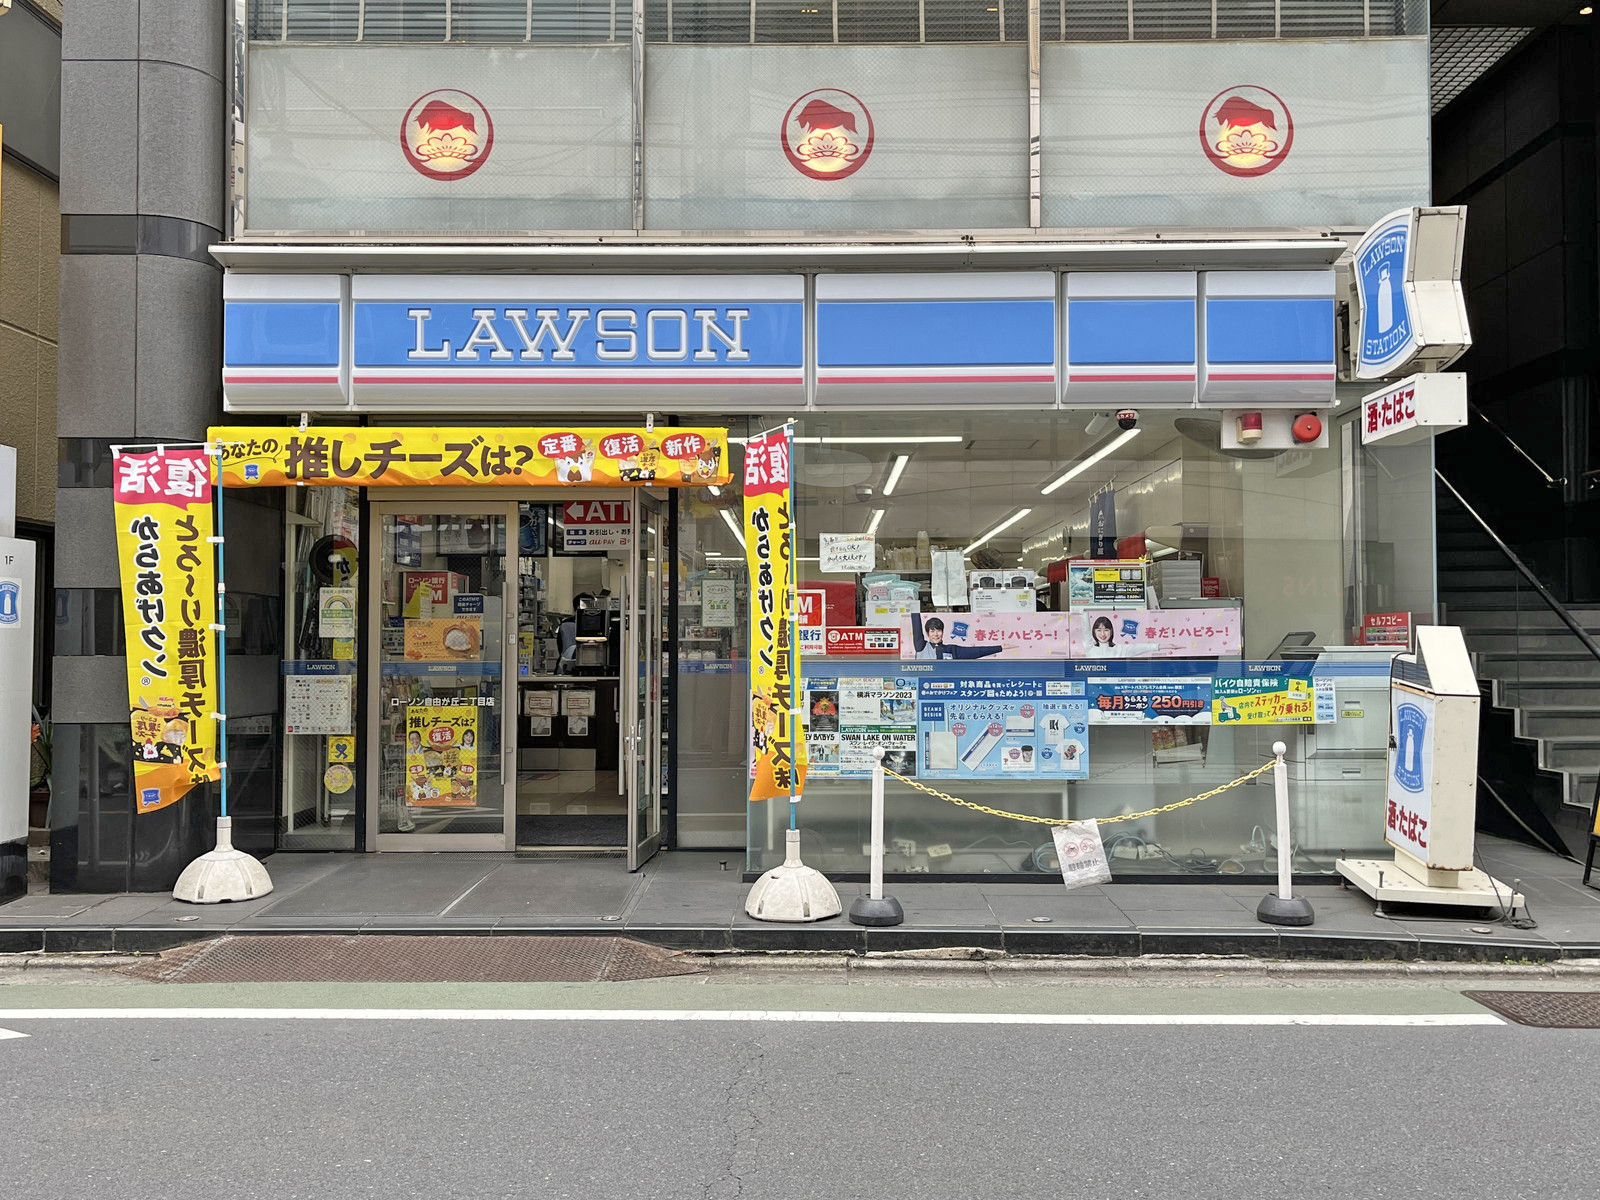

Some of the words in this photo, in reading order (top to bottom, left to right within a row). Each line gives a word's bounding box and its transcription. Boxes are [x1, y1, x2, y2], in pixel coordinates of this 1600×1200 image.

[1362, 235, 1406, 277] LAWSON
[406, 308, 751, 361] LAWSON
[1366, 320, 1406, 355] STATION
[1367, 389, 1415, 433] 酒・たばこ
[541, 434, 577, 455] 定番
[604, 434, 640, 455] 復活
[665, 436, 701, 456] 新作
[285, 435, 534, 479] 推しチーズは?
[5, 555, 15, 565] 1F
[1370, 615, 1403, 626] セルフコピー
[841, 632, 863, 641] ATM
[1214, 678, 1279, 688] バイク自賠責保険
[391, 697, 495, 706] ローソン自由が丘二丁目店
[857, 691, 913, 699] 横浜マラソン2023
[1097, 695, 1124, 710] 毎月
[432, 731, 452, 742] 復活
[1387, 799, 1428, 849] 酒・たばこ
